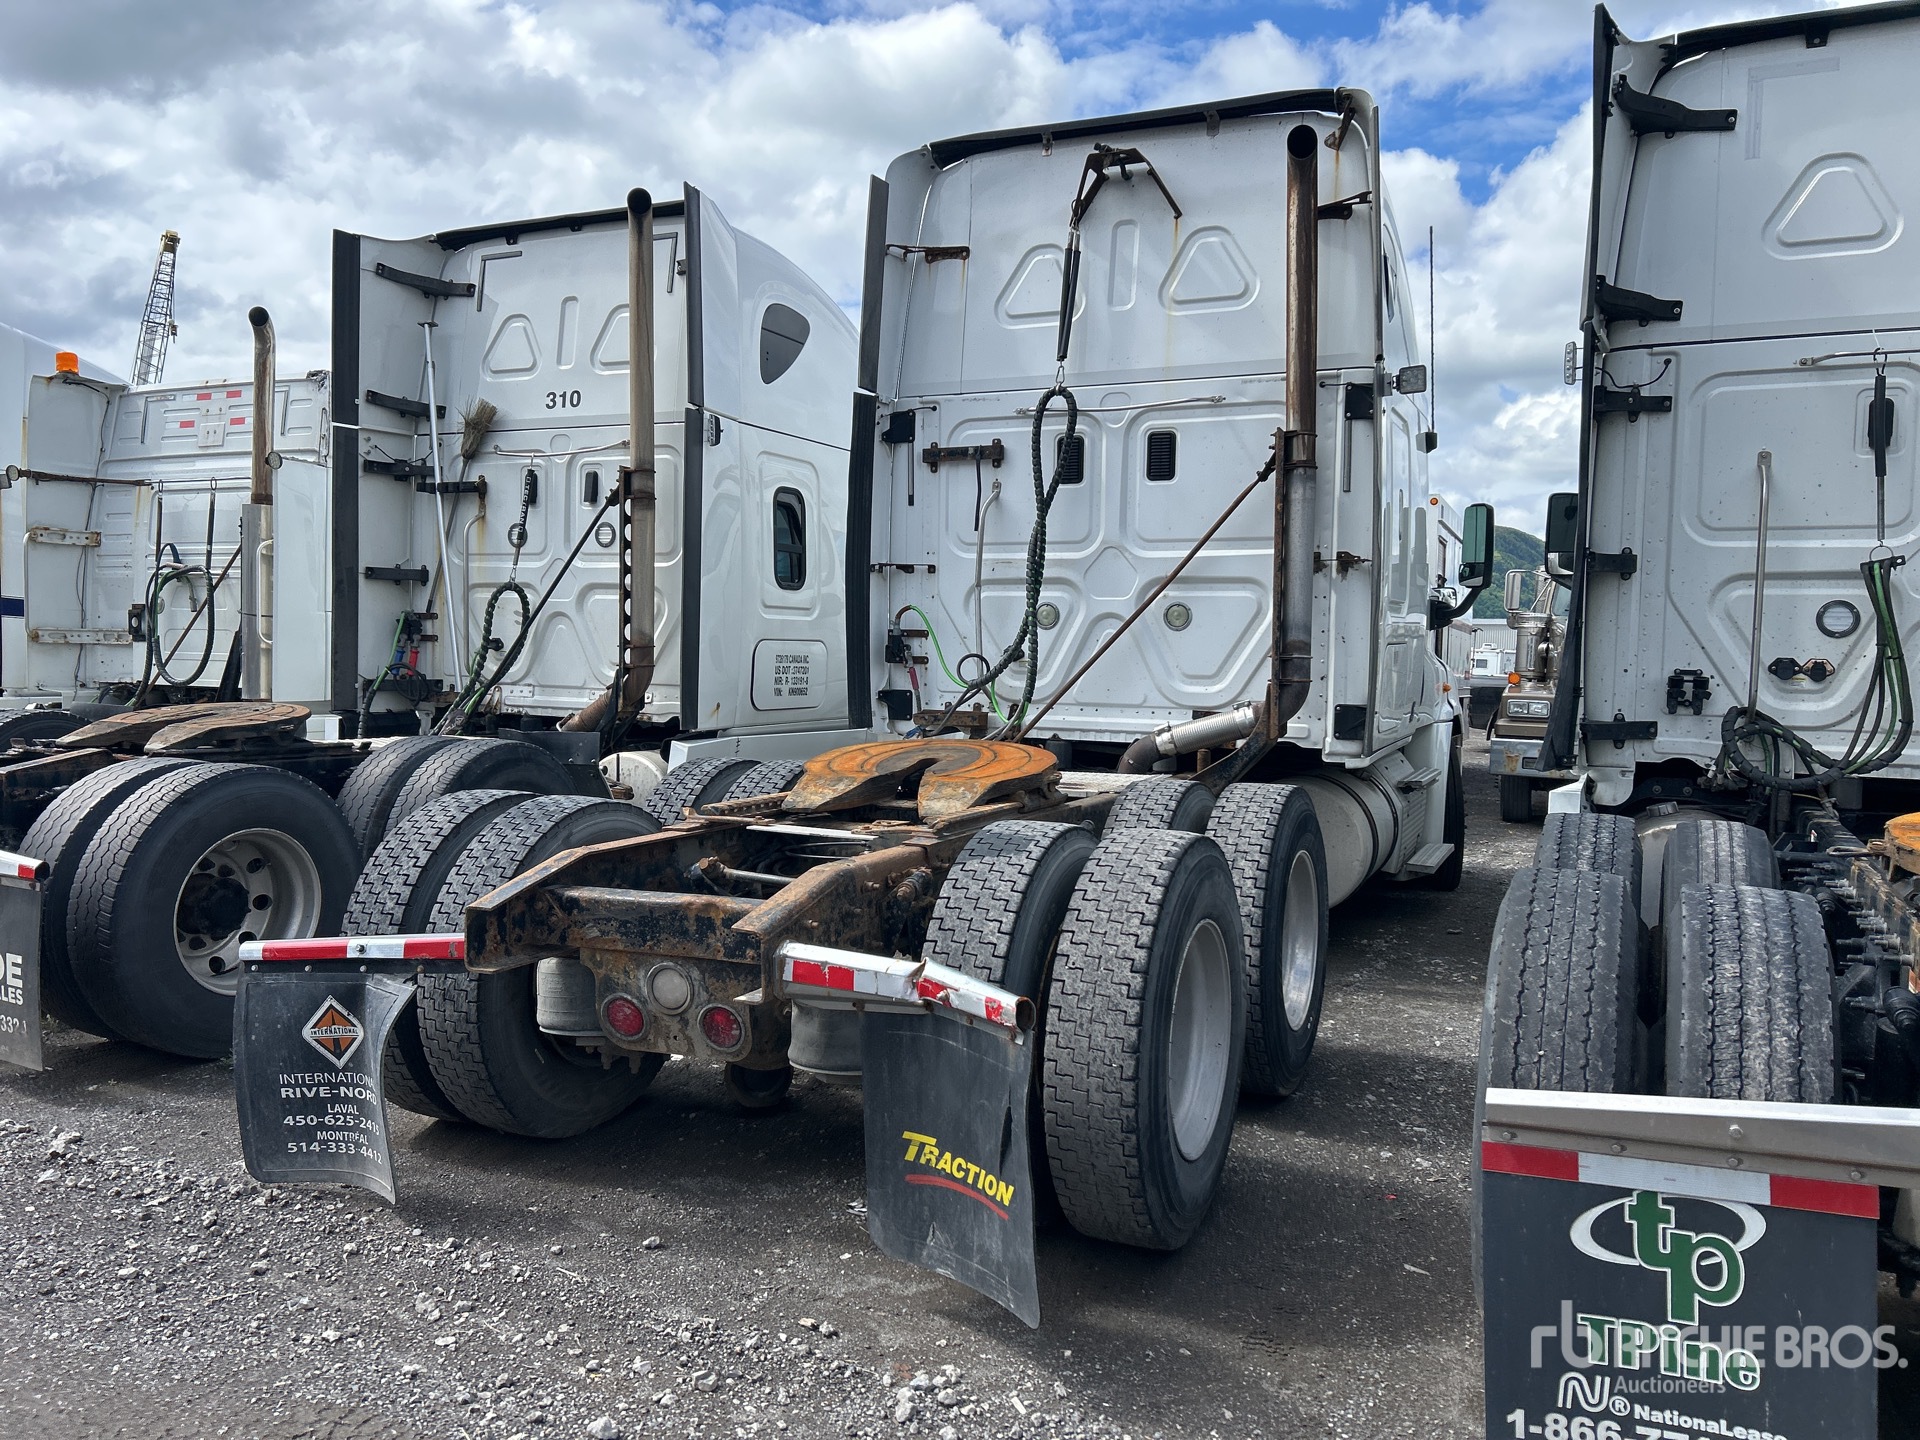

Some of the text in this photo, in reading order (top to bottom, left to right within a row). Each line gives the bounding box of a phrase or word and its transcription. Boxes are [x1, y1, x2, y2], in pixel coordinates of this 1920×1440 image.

[545, 389, 582, 410] 310
[774, 666, 781, 675] US
[782, 666, 791, 675] DOT
[310, 1026, 359, 1036] INTERNATIONAL
[280, 1086, 377, 1105] RIVE-NORD
[327, 1104, 360, 1114] LAVAL
[283, 1114, 380, 1136] 450-625-2415
[287, 1142, 383, 1165] 514-333-4412
[1577, 1312, 1761, 1391] TPine
